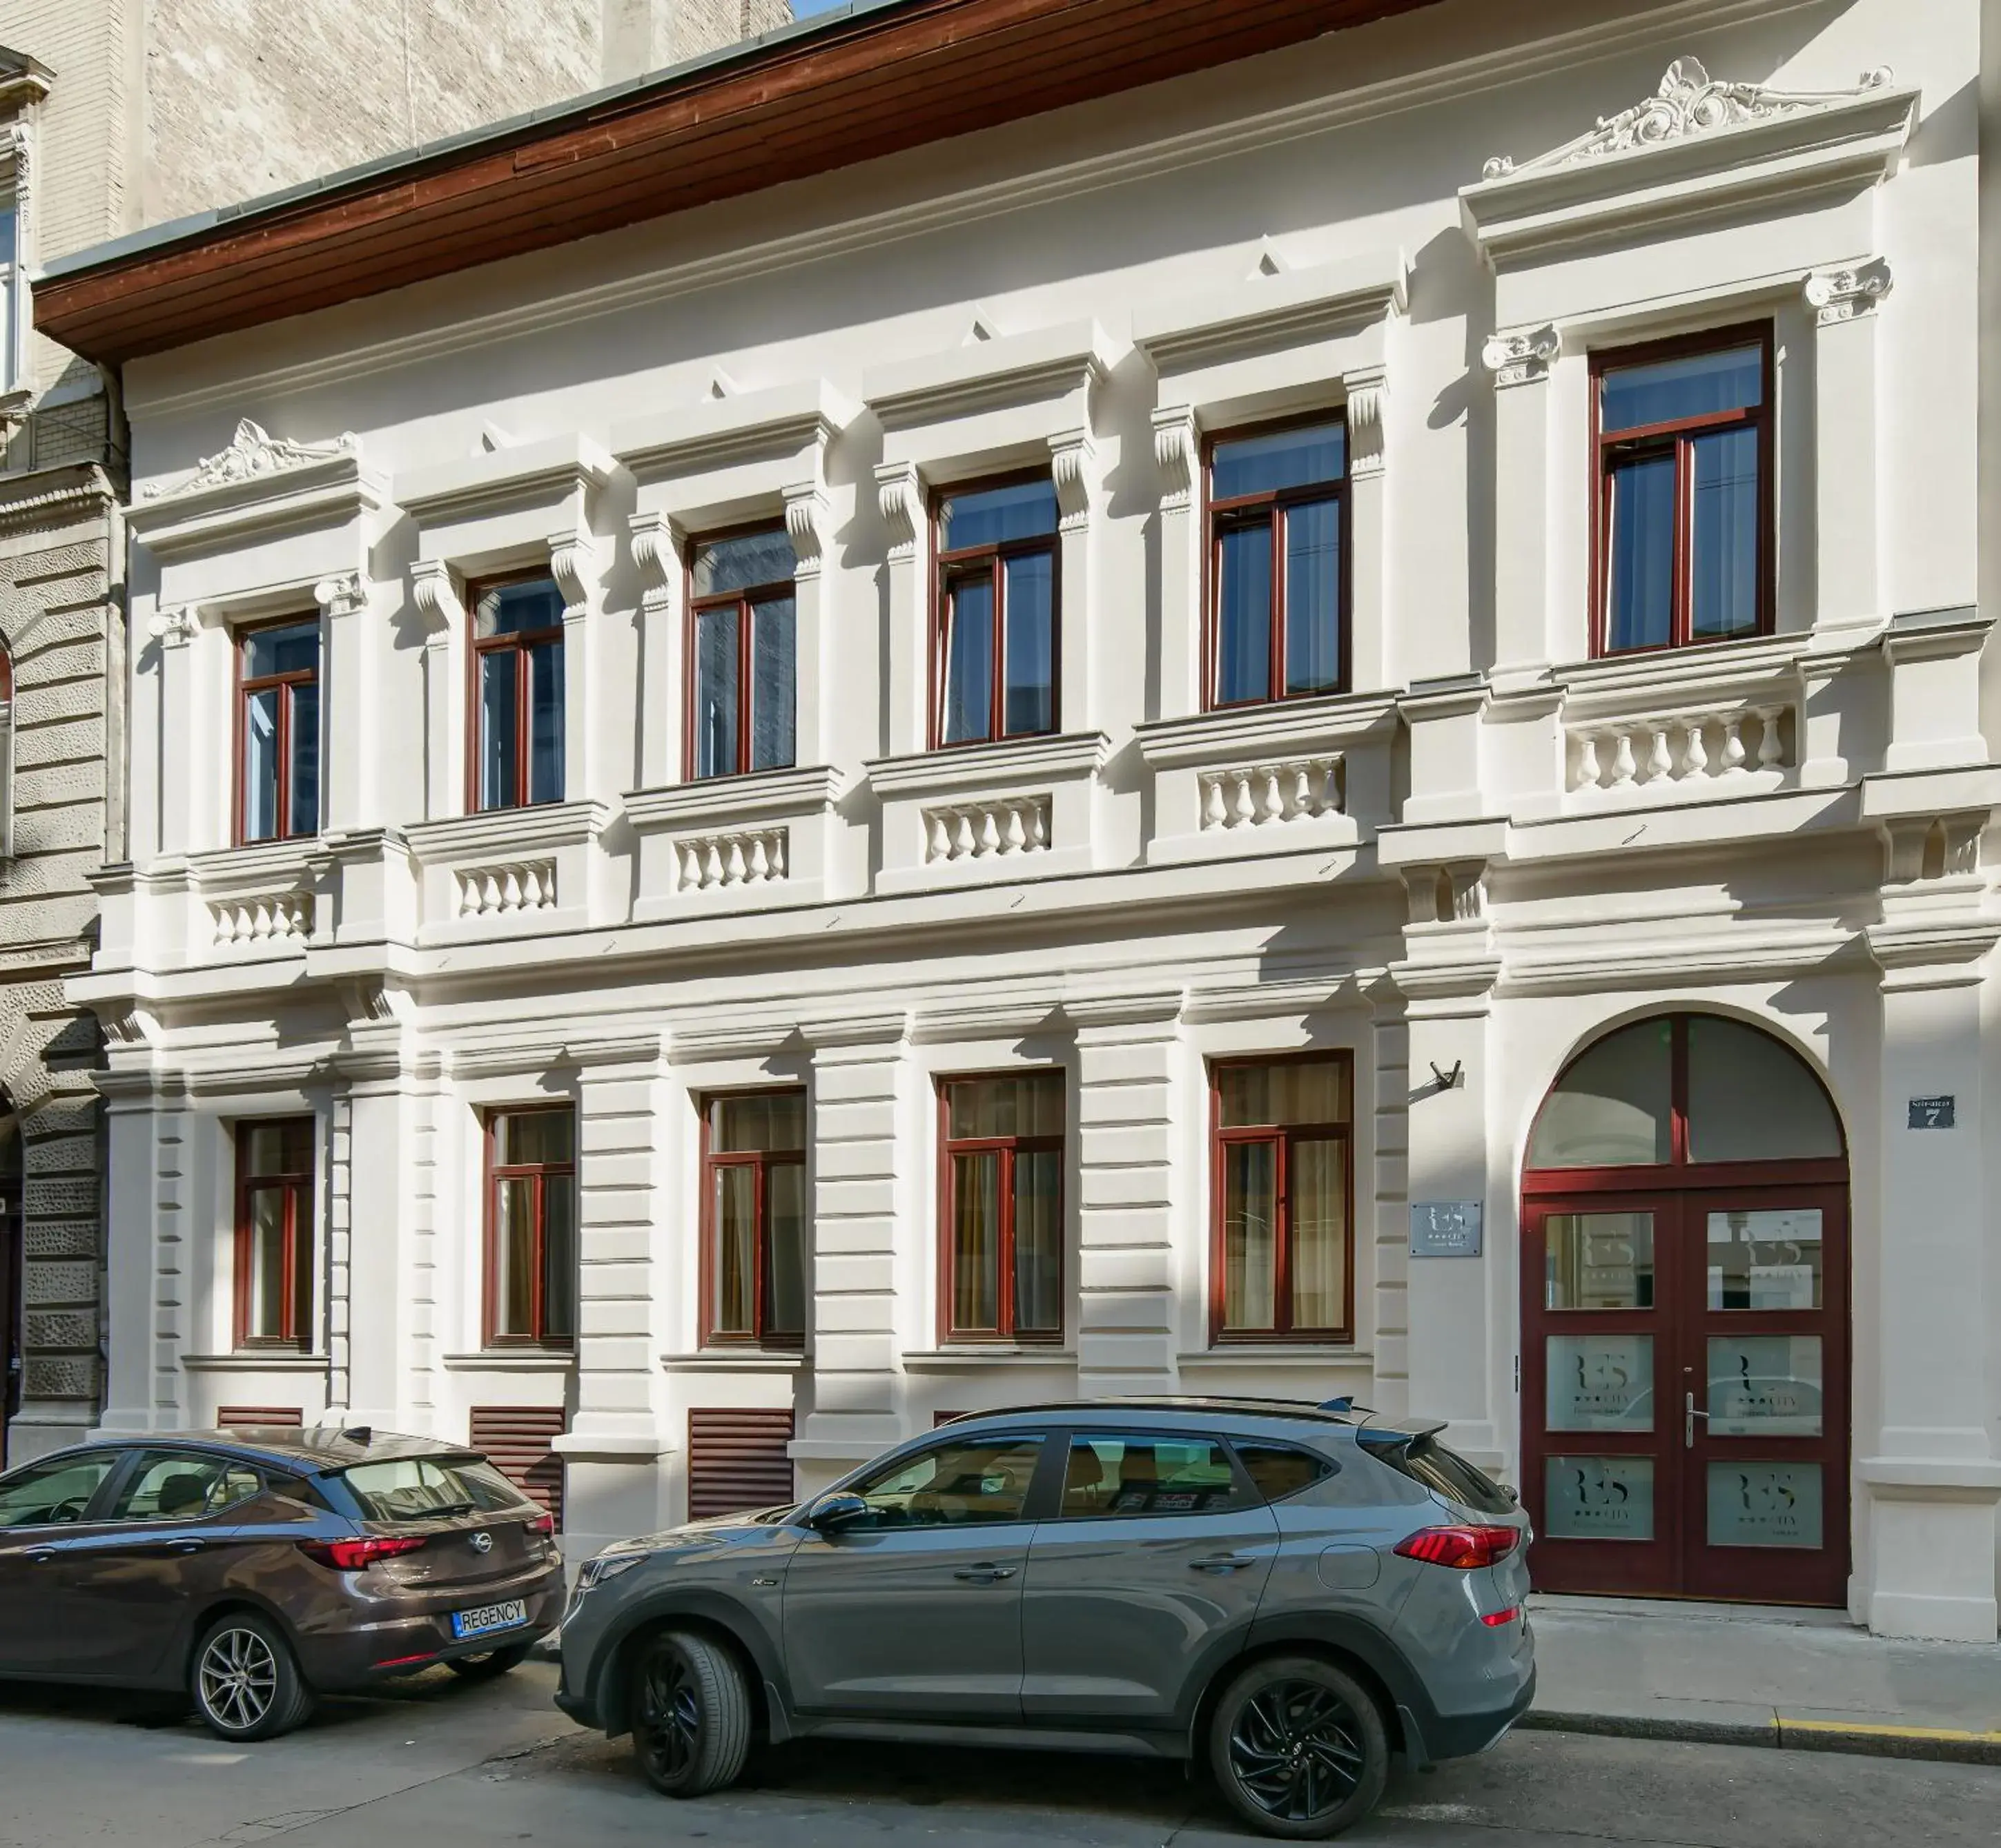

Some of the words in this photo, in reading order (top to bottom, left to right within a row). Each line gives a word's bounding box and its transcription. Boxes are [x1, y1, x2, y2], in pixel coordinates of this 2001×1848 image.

[1926, 1109, 1940, 1125] 7
[1768, 1396, 1796, 1406] CITY
[462, 1601, 521, 1630] REGENCY
